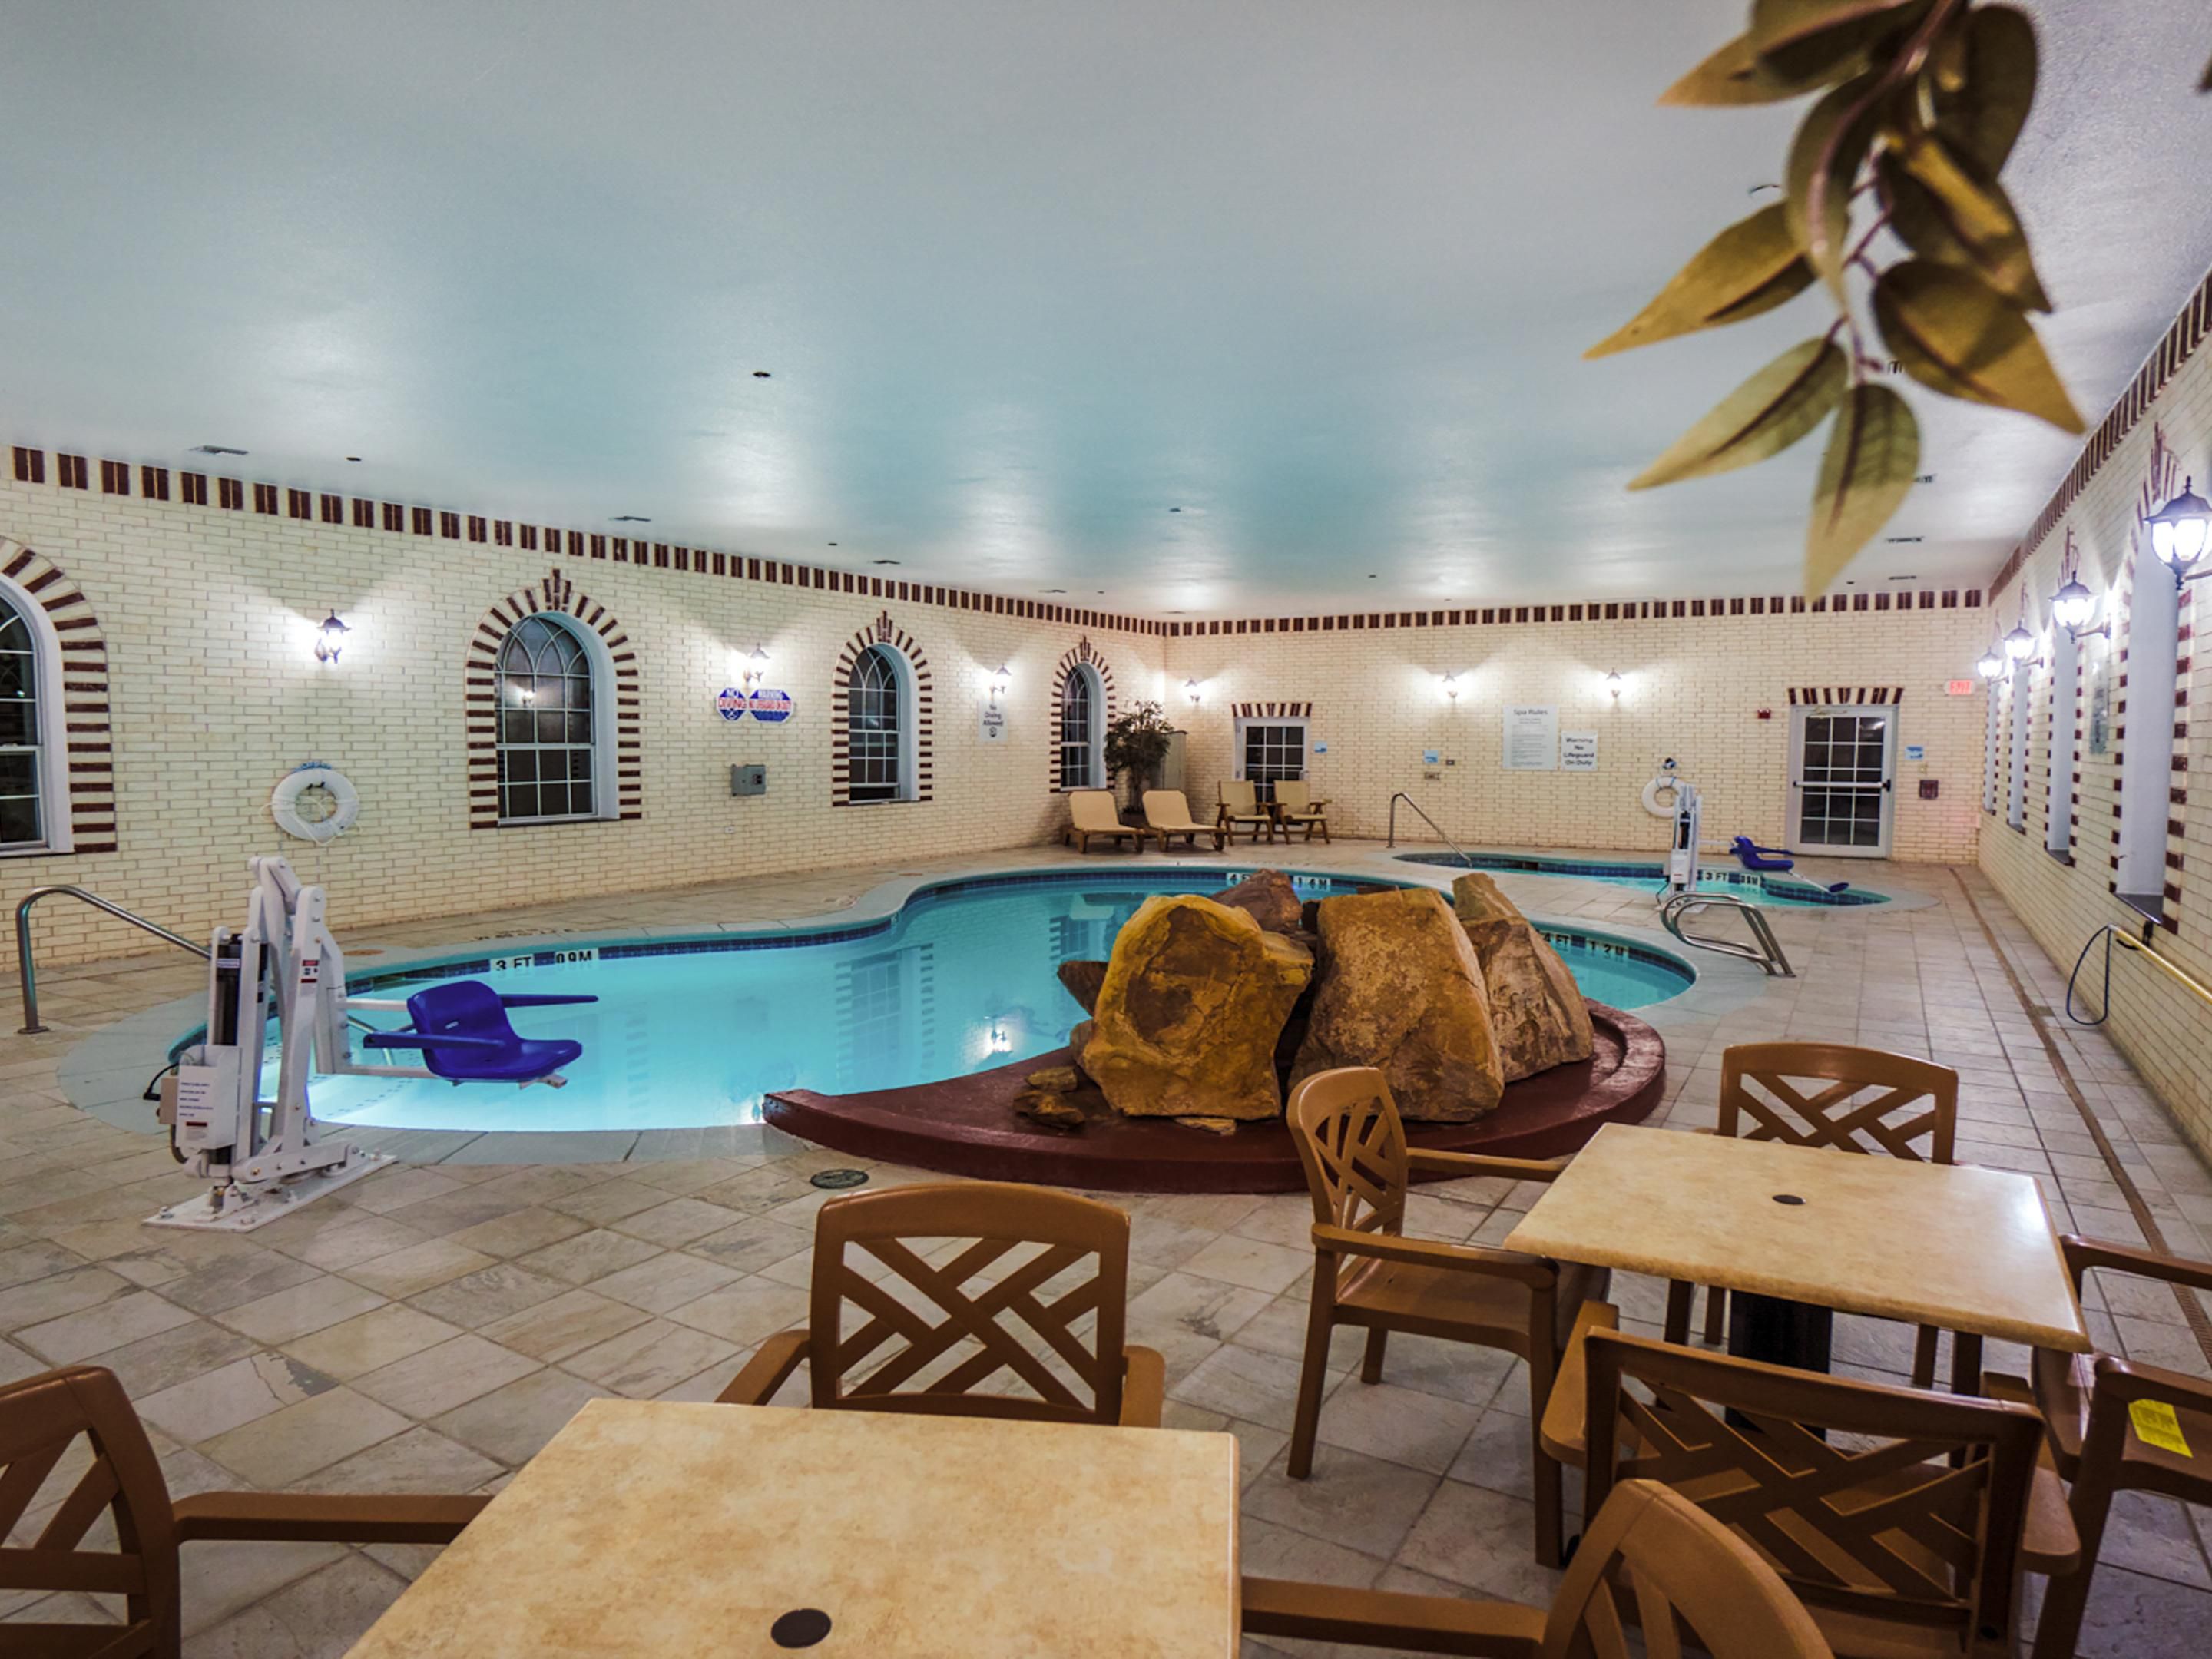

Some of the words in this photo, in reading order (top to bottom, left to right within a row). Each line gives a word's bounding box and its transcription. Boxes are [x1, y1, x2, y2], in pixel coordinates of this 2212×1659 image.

[1706, 872, 1713, 881] 3
[1716, 873, 1727, 881] FT
[496, 959, 507, 971] 3
[514, 956, 531, 969] FT
